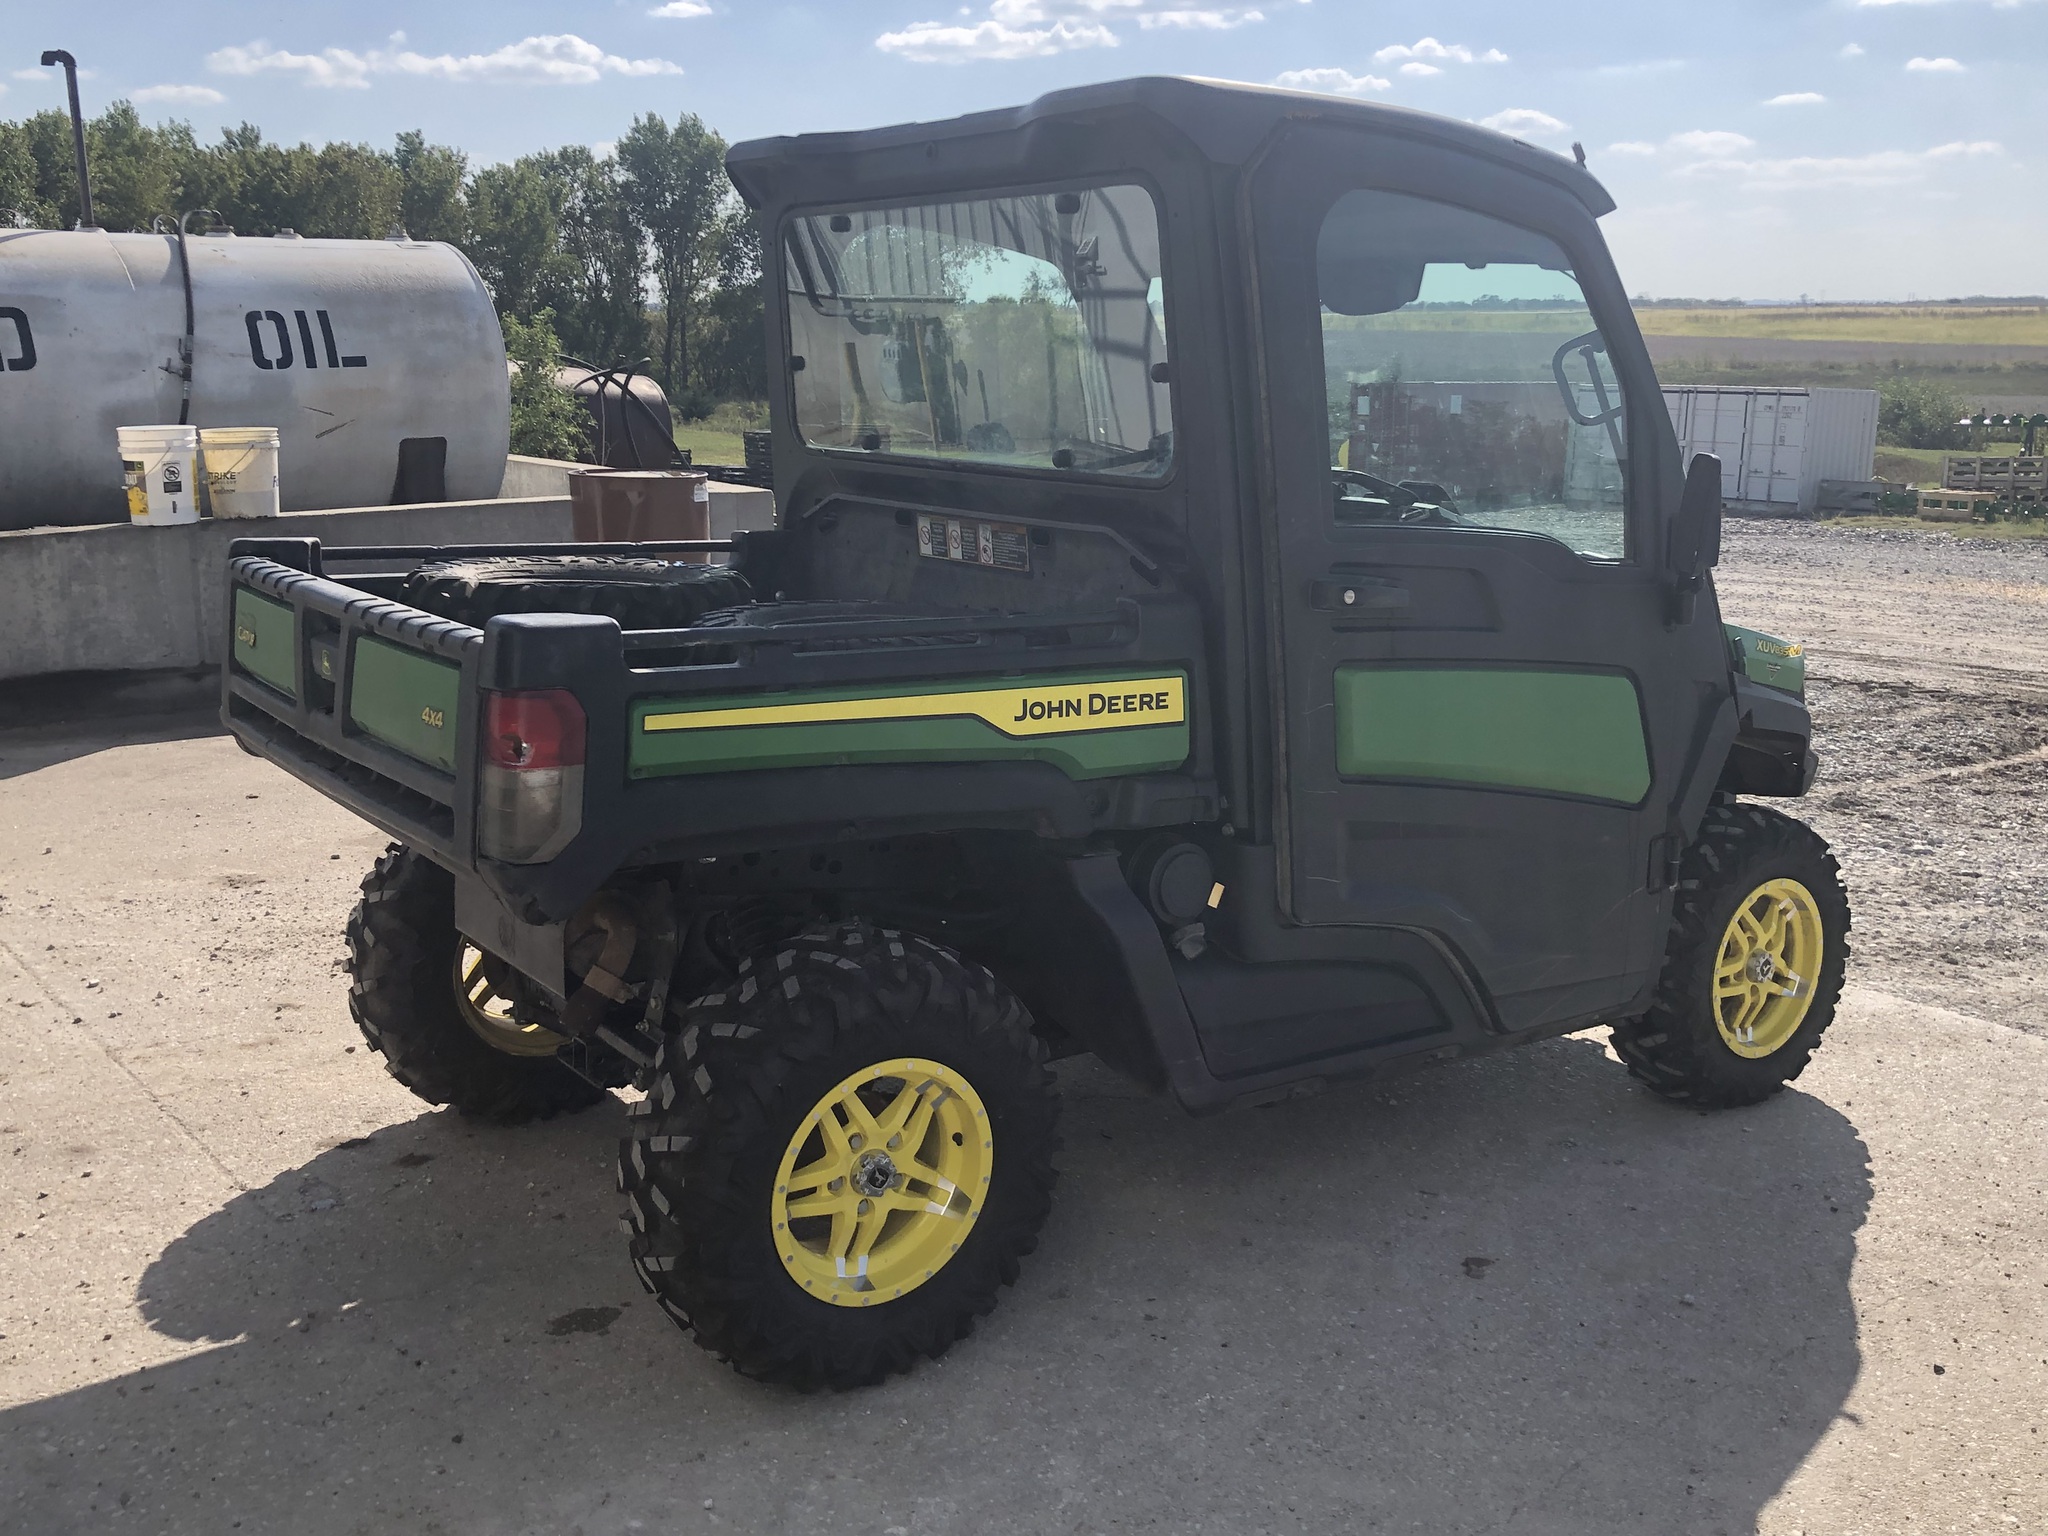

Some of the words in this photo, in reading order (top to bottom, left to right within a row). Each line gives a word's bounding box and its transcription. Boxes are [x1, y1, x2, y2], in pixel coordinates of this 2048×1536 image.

[245, 310, 367, 369] OIL
[1014, 698, 1081, 722] JOHN
[1088, 691, 1169, 716] DEERE
